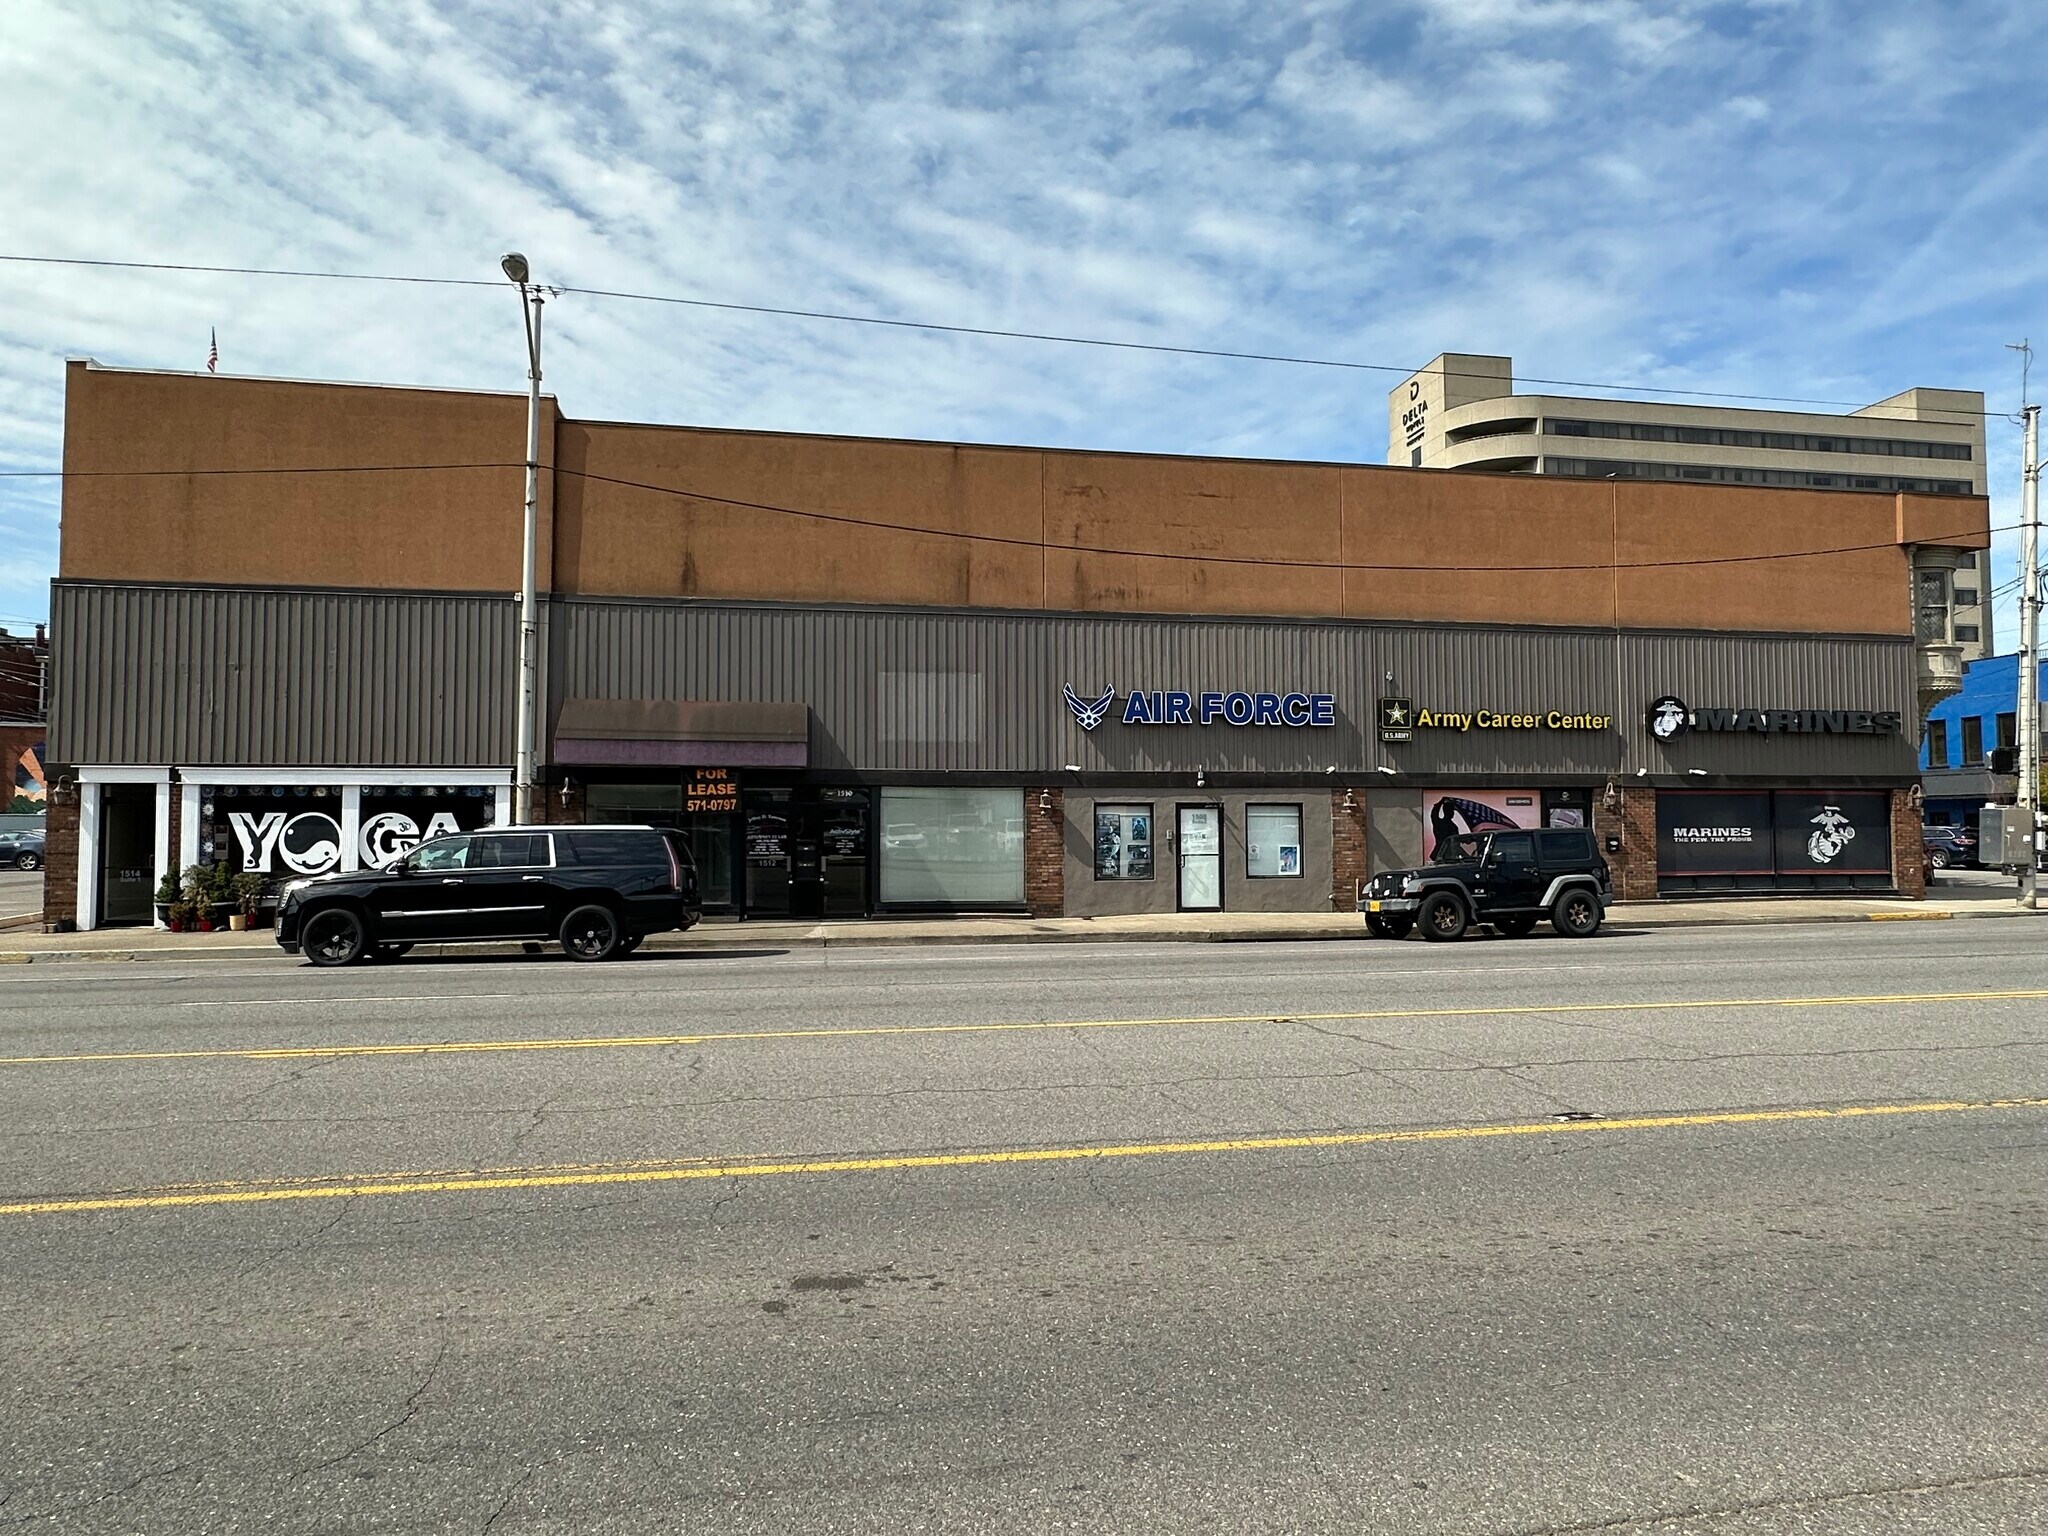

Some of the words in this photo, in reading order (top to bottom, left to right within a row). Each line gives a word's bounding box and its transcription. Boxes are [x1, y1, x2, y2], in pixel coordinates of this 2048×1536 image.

[1402, 400, 1428, 427] DELTA
[1122, 691, 1193, 724] AIR
[1200, 691, 1335, 726] FORCE
[1417, 708, 1472, 732] Army
[1476, 709, 1543, 728] Career
[1547, 710, 1611, 729] Center
[1693, 708, 1902, 734] MARINES
[696, 769, 728, 779] FOR
[687, 783, 737, 795] LEASE
[687, 799, 737, 812] 571-0797
[1673, 827, 1752, 837] MARINES
[120, 869, 141, 877] 1514
